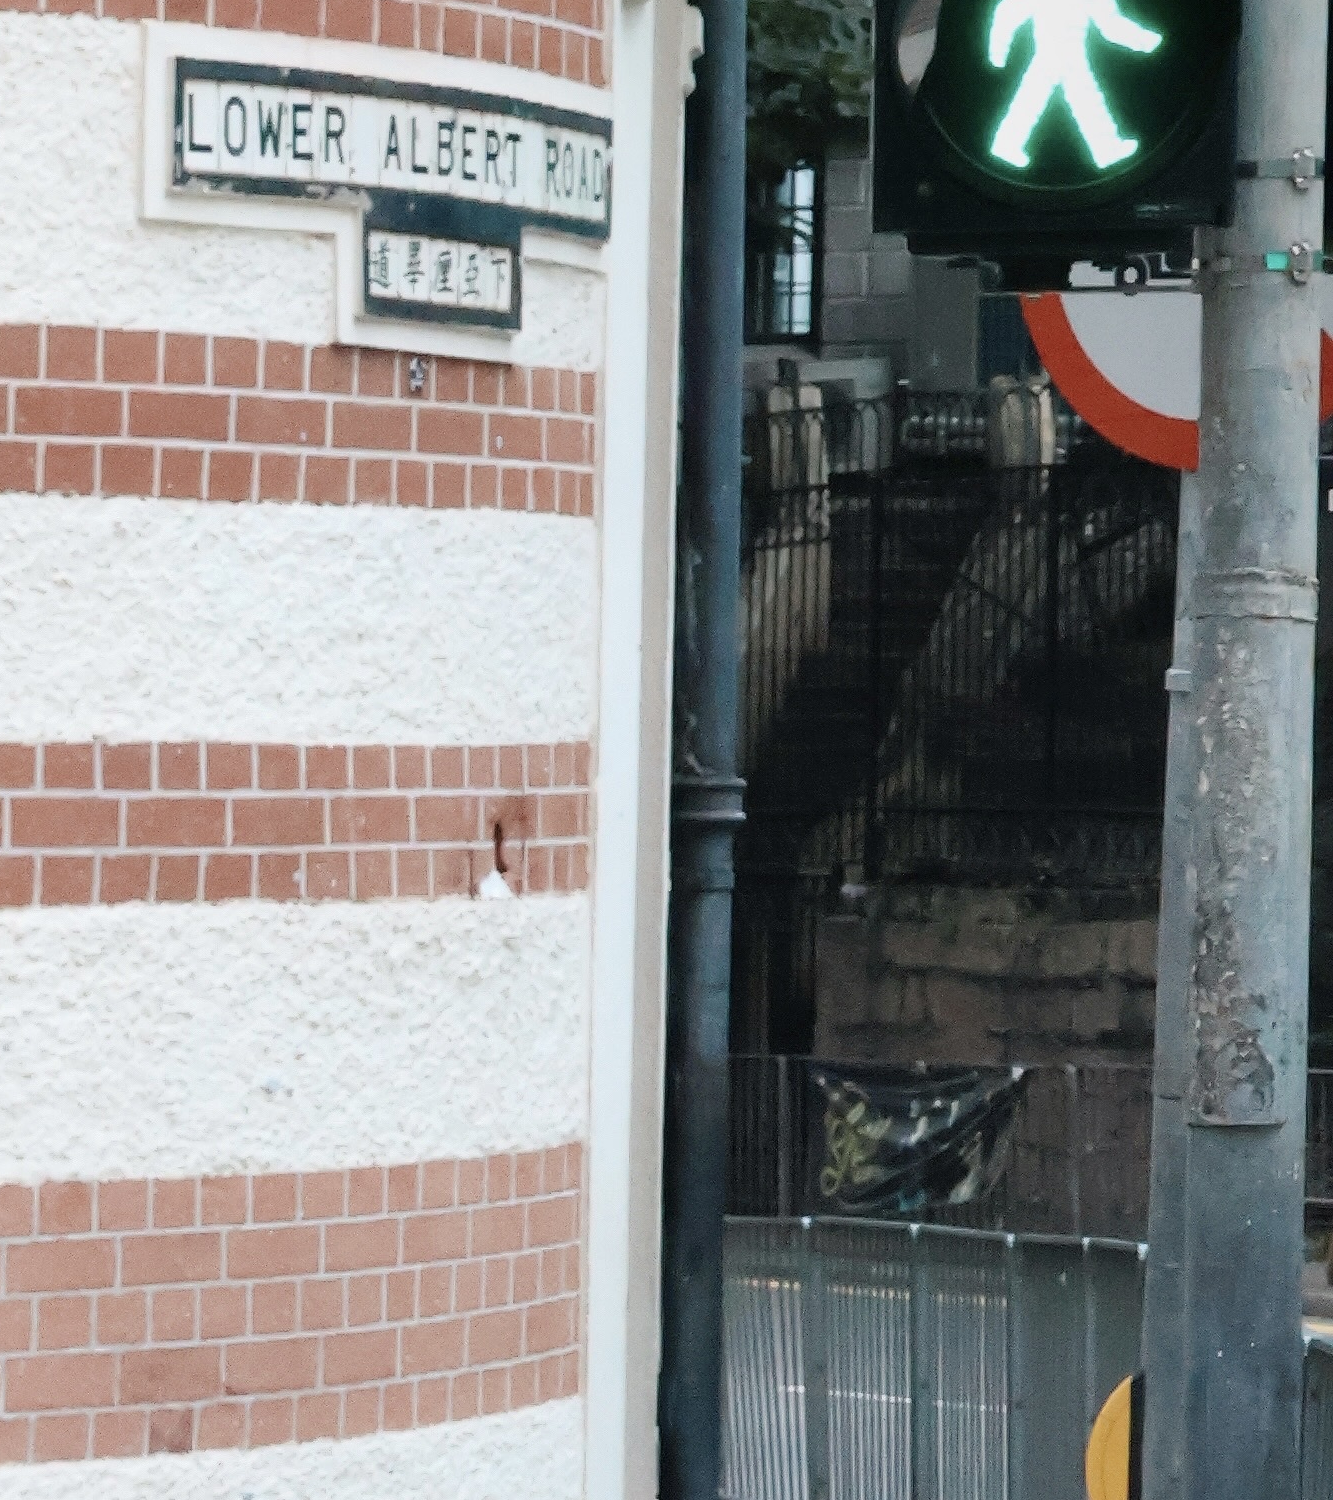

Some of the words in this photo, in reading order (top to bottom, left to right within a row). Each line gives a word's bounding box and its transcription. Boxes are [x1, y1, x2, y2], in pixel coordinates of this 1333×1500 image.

[187, 92, 346, 164] LOWER
[383, 112, 523, 189] ALBERT
[546, 137, 604, 202] ROAD
